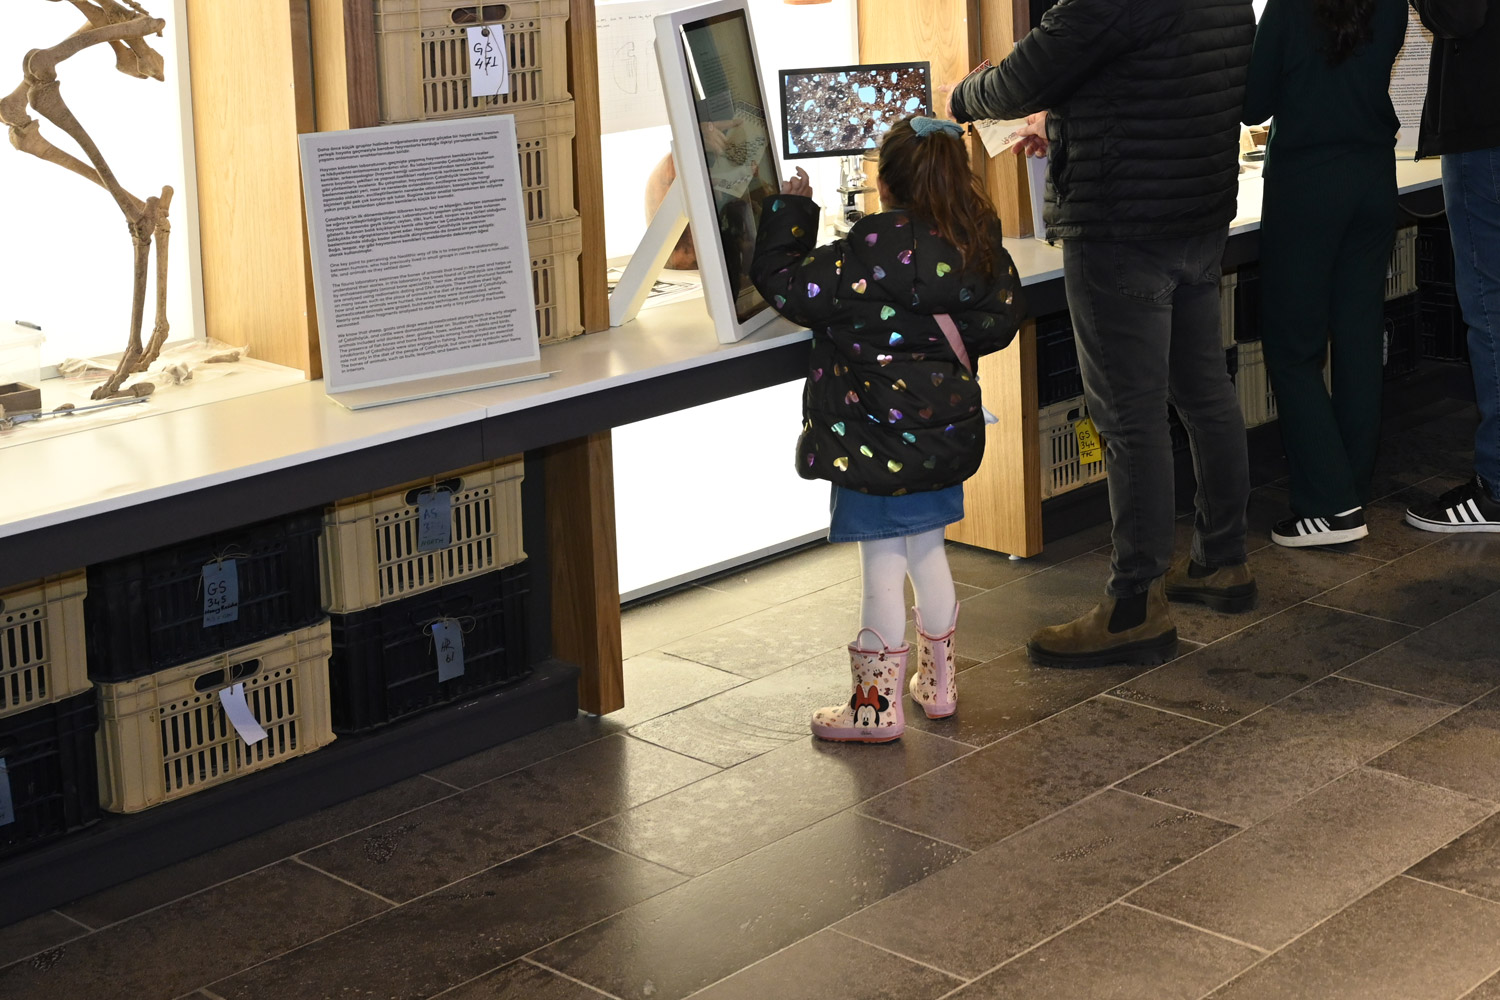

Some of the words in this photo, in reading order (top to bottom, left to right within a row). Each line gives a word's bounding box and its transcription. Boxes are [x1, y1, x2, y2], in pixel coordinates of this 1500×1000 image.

[474, 42, 493, 56] GS
[1079, 430, 1090, 441] GS
[1081, 441, 1095, 450] 344
[207, 580, 227, 596] GS
[207, 595, 227, 607] 345
